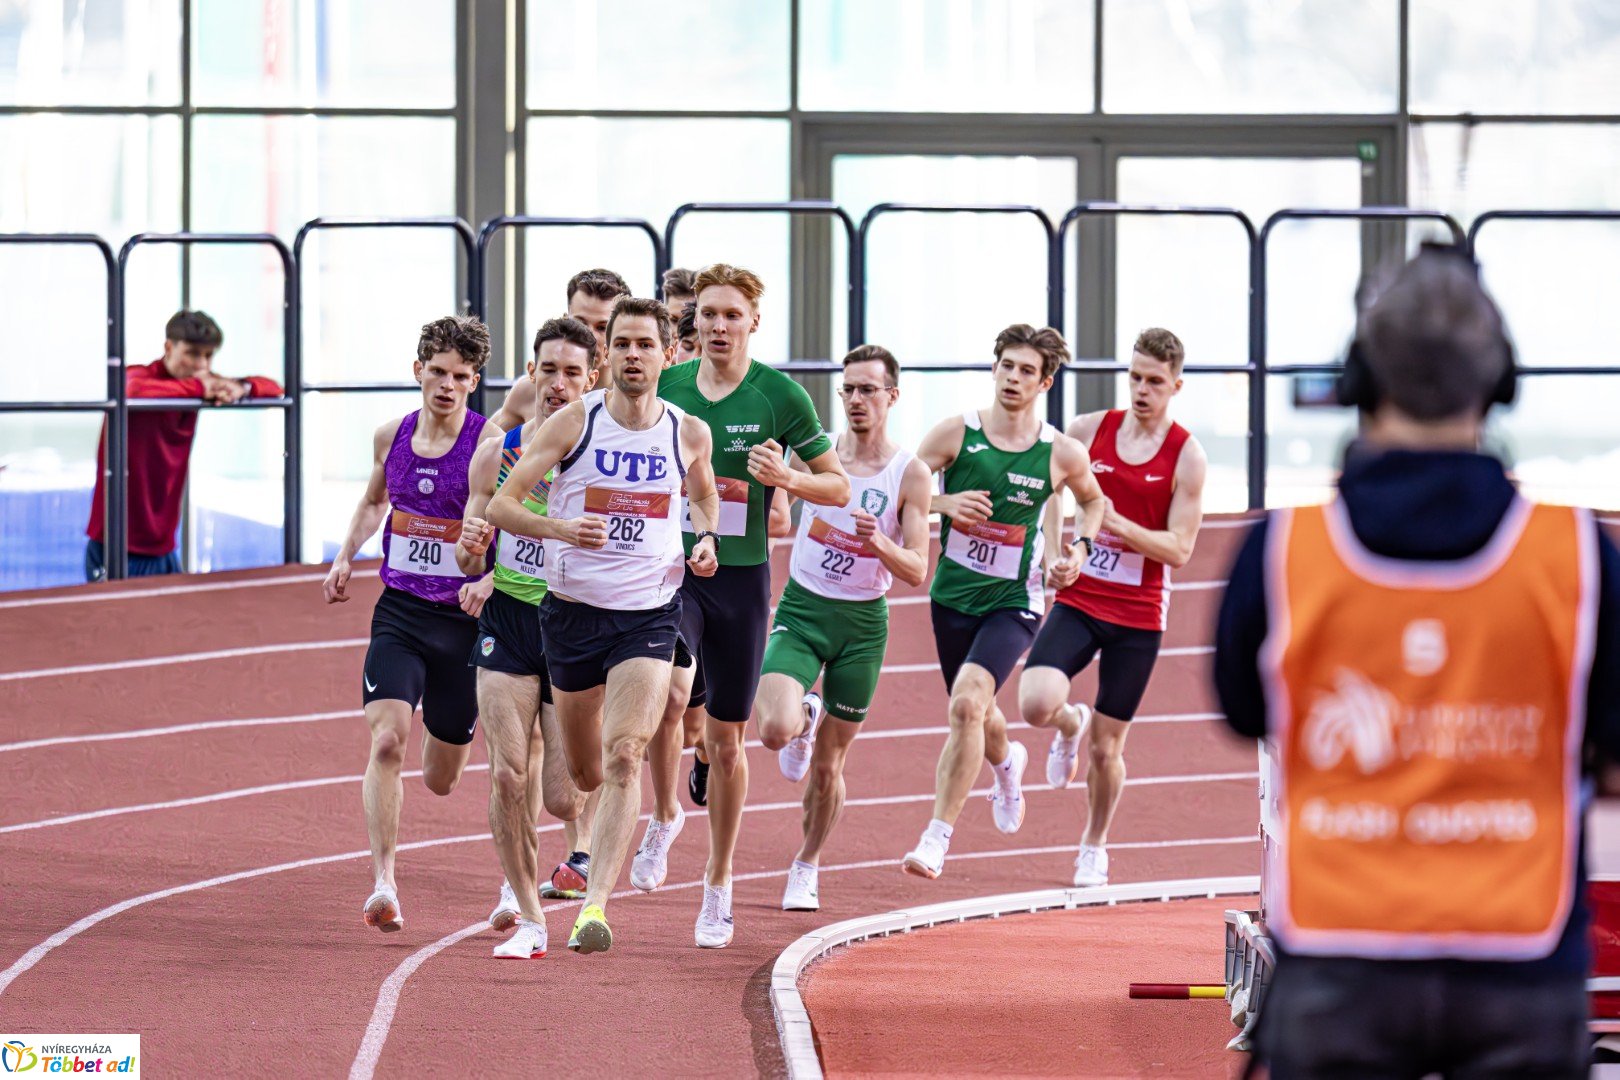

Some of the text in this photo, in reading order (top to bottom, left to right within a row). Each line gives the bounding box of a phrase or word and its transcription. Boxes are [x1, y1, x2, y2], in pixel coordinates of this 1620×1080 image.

[595, 449, 667, 482] UTE
[608, 517, 645, 542] 262
[408, 540, 442, 565] 240
[515, 539, 545, 568] 220
[615, 542, 635, 551] VINDICS
[967, 540, 998, 566] 201
[821, 549, 855, 576] 222
[1089, 547, 1121, 572] 227
